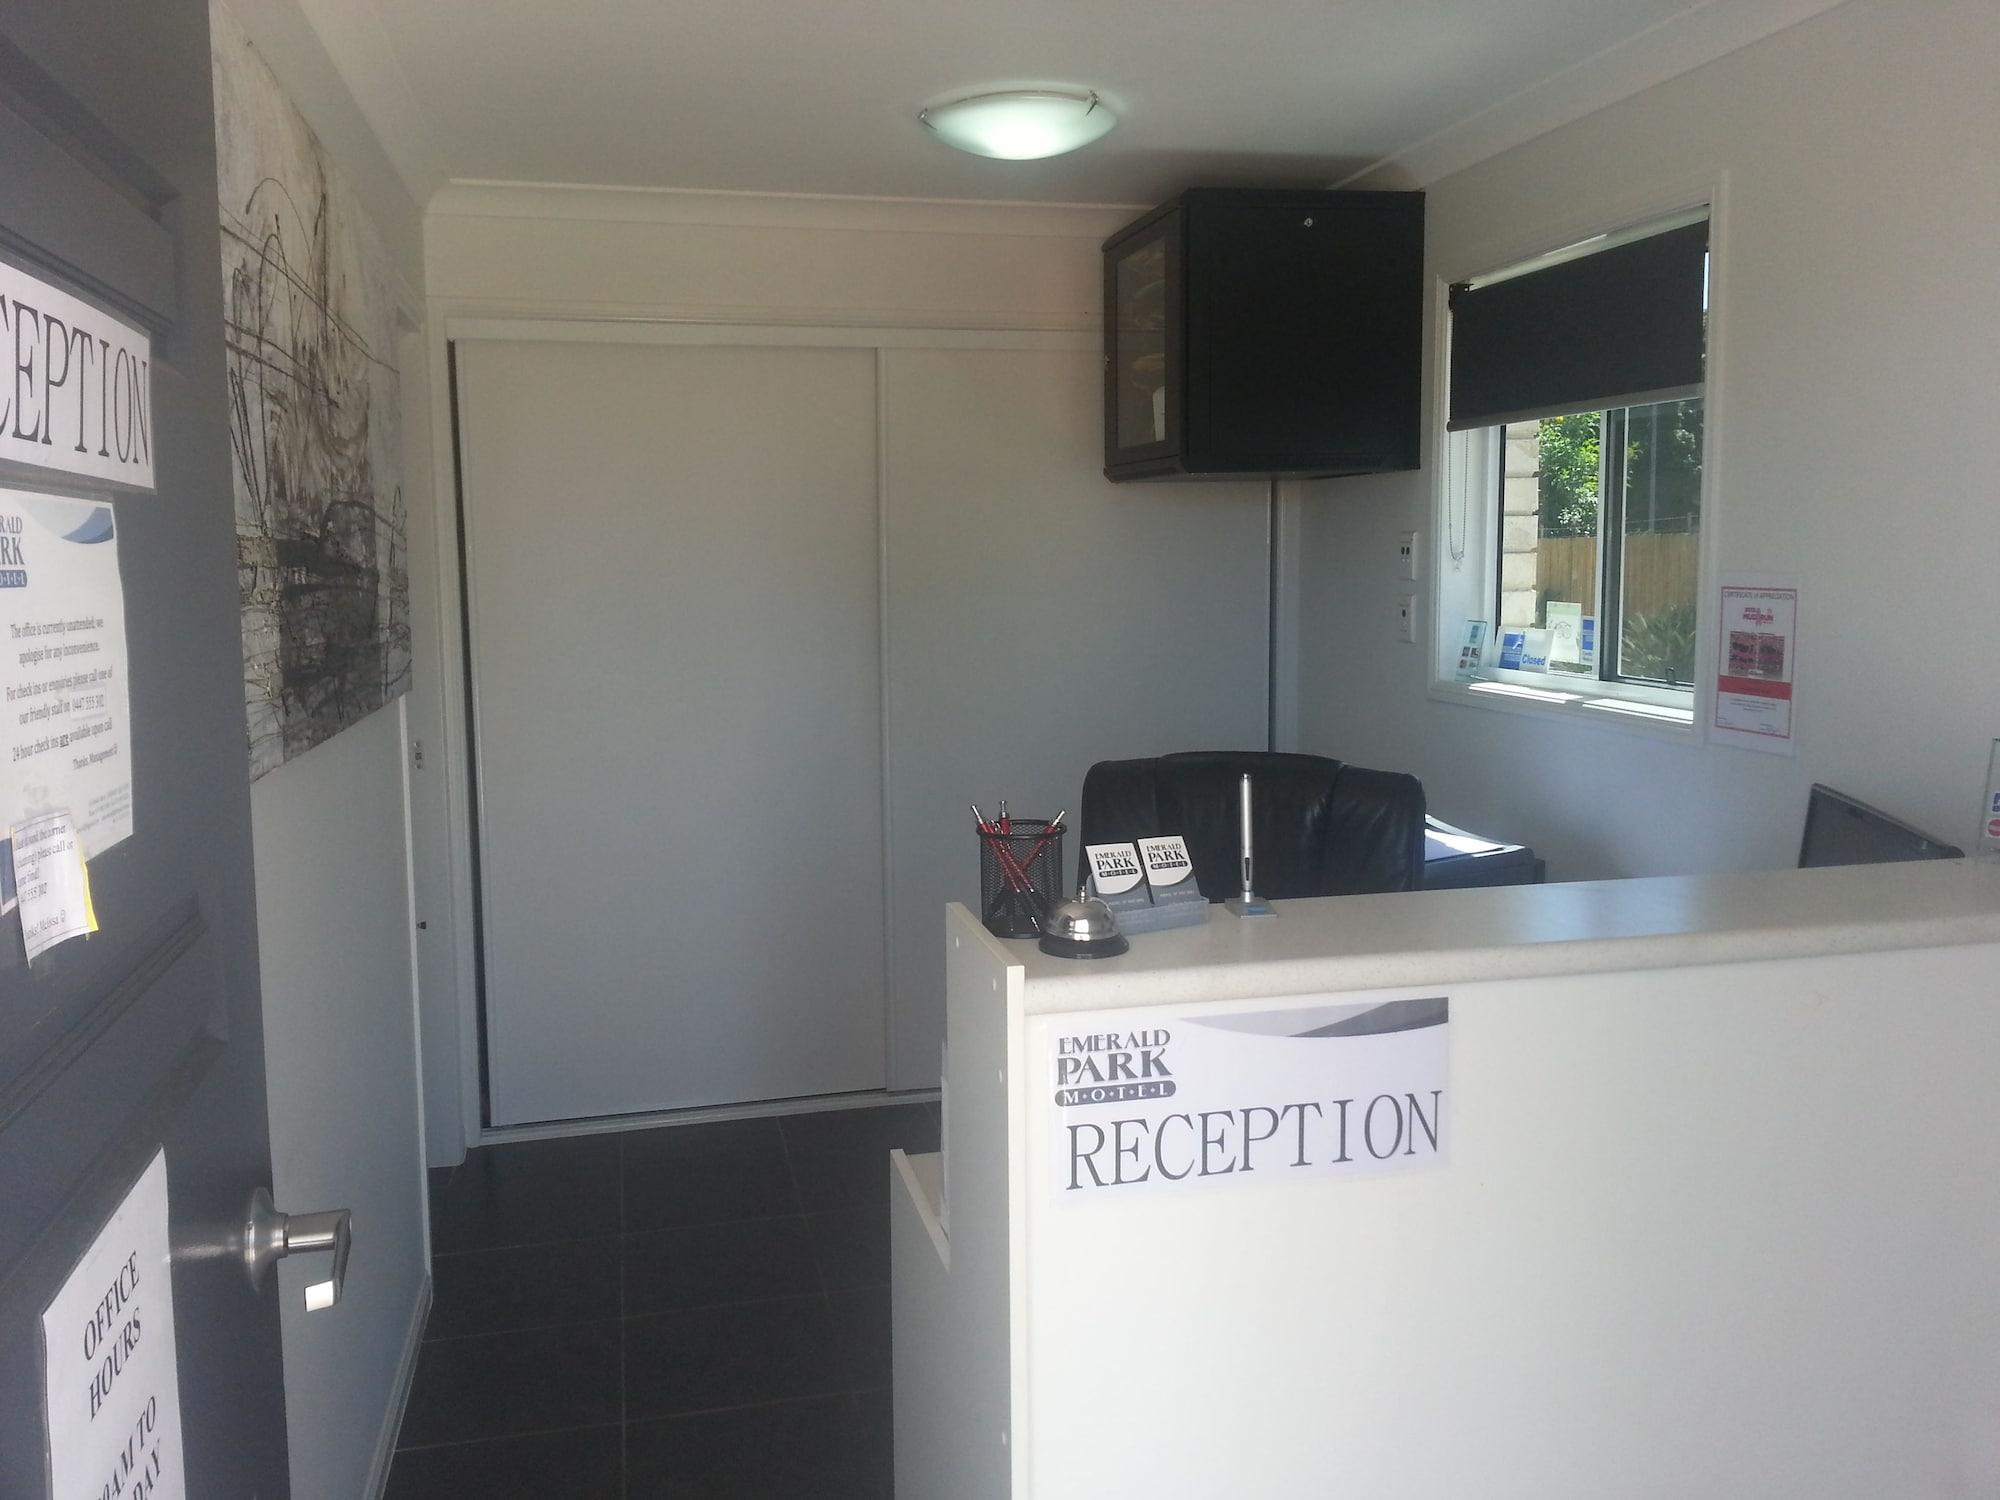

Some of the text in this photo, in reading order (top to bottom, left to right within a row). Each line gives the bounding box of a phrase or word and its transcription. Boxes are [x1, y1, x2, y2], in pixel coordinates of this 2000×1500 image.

[10, 624, 21, 639] The
[21, 622, 36, 638] office
[42, 619, 65, 635] currently
[44, 645, 52, 659] for
[53, 648, 62, 661] any
[1521, 653, 1546, 666] Closed
[6, 686, 15, 702] For
[17, 682, 32, 699] check
[42, 682, 48, 692] or
[72, 673, 88, 689] please
[89, 668, 97, 682] call
[98, 671, 107, 681] one
[107, 665, 113, 679] of
[19, 712, 29, 725] our
[30, 704, 50, 721] friendly
[51, 700, 63, 716] staff
[63, 702, 70, 712] on
[12, 747, 20, 762] 24
[20, 744, 34, 759] hour
[34, 737, 49, 754] check
[60, 734, 69, 748] are
[69, 724, 91, 742] available
[91, 722, 104, 737] upon
[104, 716, 113, 732] call
[1094, 850, 1132, 860] EMERALD
[1146, 843, 1182, 852] EMERALD
[1148, 850, 1185, 863] PARK
[1096, 857, 1135, 870] PARK
[1058, 1028, 1171, 1055] EMERALD
[1057, 1047, 1174, 1086] PARK
[1065, 1090, 1443, 1191] RECEPTION
[83, 1249, 140, 1361] OFFICE
[89, 1306, 142, 1422] HOURS
[136, 1395, 156, 1452] TO
